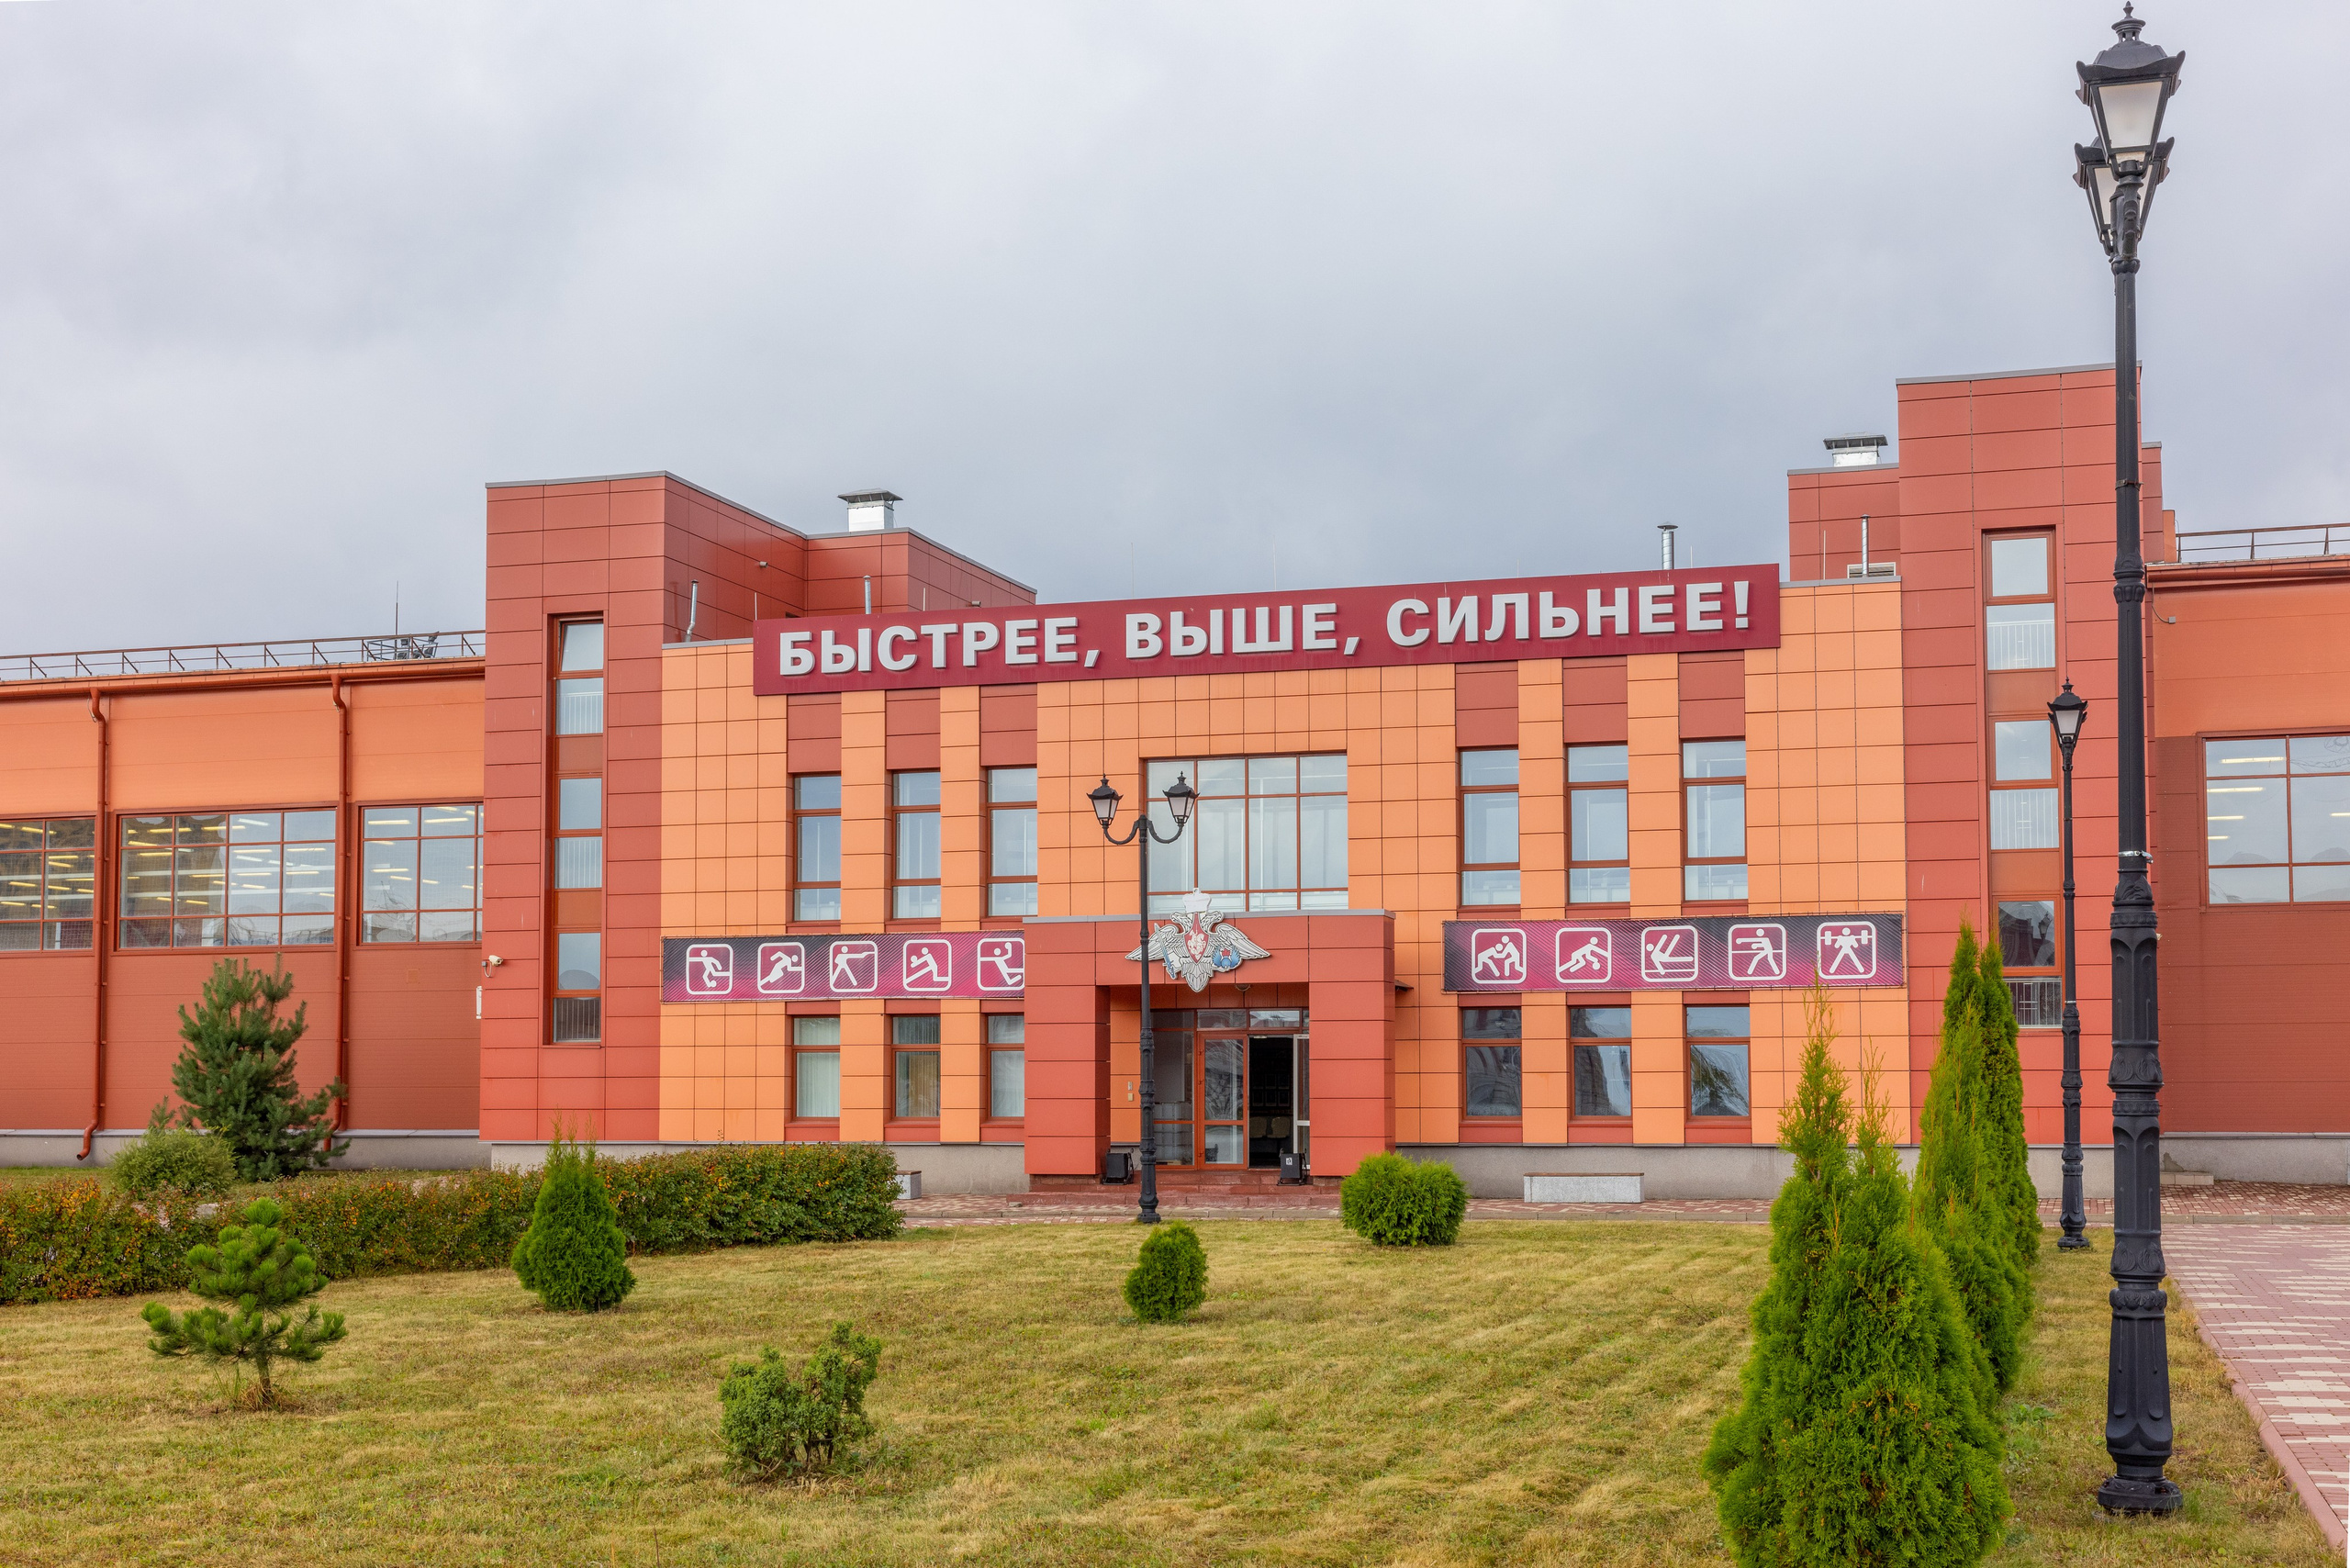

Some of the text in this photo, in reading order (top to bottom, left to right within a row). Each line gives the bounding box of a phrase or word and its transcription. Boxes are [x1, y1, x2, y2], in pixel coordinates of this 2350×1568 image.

[778, 580, 1751, 677] БЫСТРЕЕ, ВЫШЕ, СИЛЬНЕЕ!
